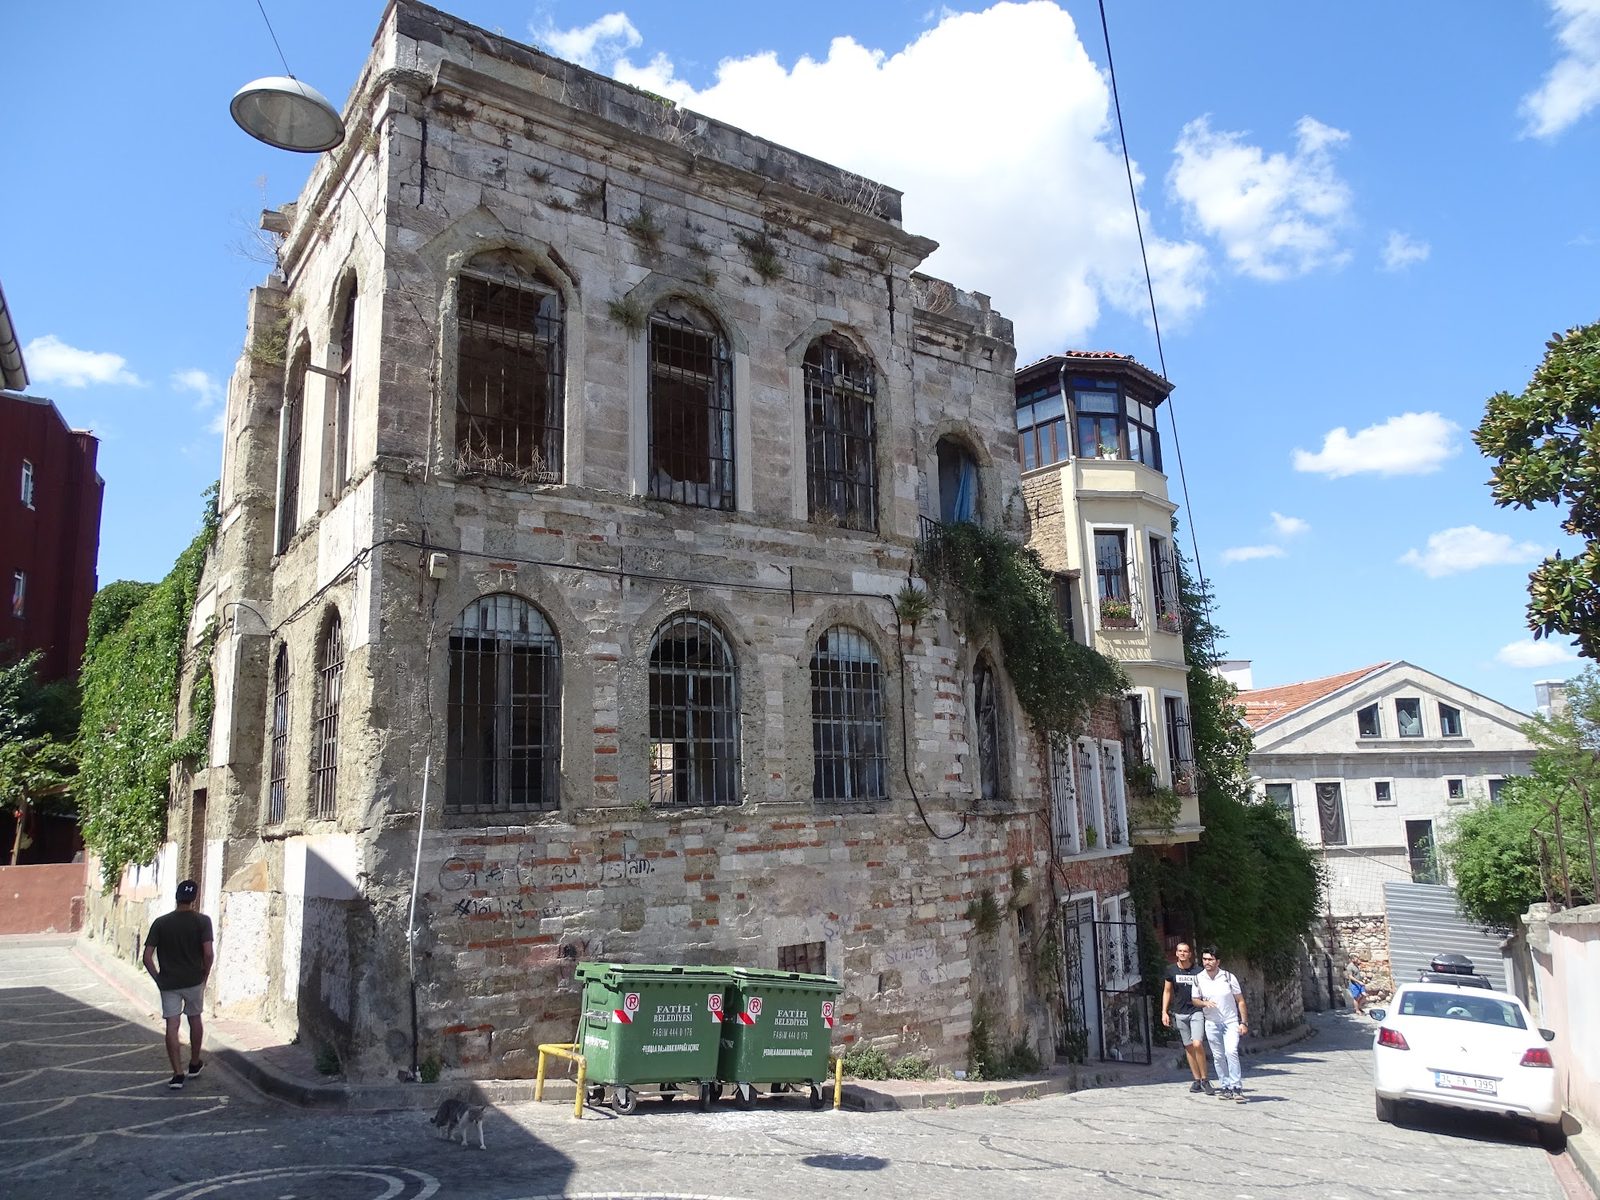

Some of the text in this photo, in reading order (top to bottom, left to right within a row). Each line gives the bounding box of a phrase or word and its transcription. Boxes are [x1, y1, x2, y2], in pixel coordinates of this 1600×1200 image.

[656, 1003, 691, 1014] FATİH
[776, 1009, 807, 1018] FATİH
[653, 1012, 693, 1022] BELEDİYESİ
[1474, 1079, 1494, 1089] 1395
